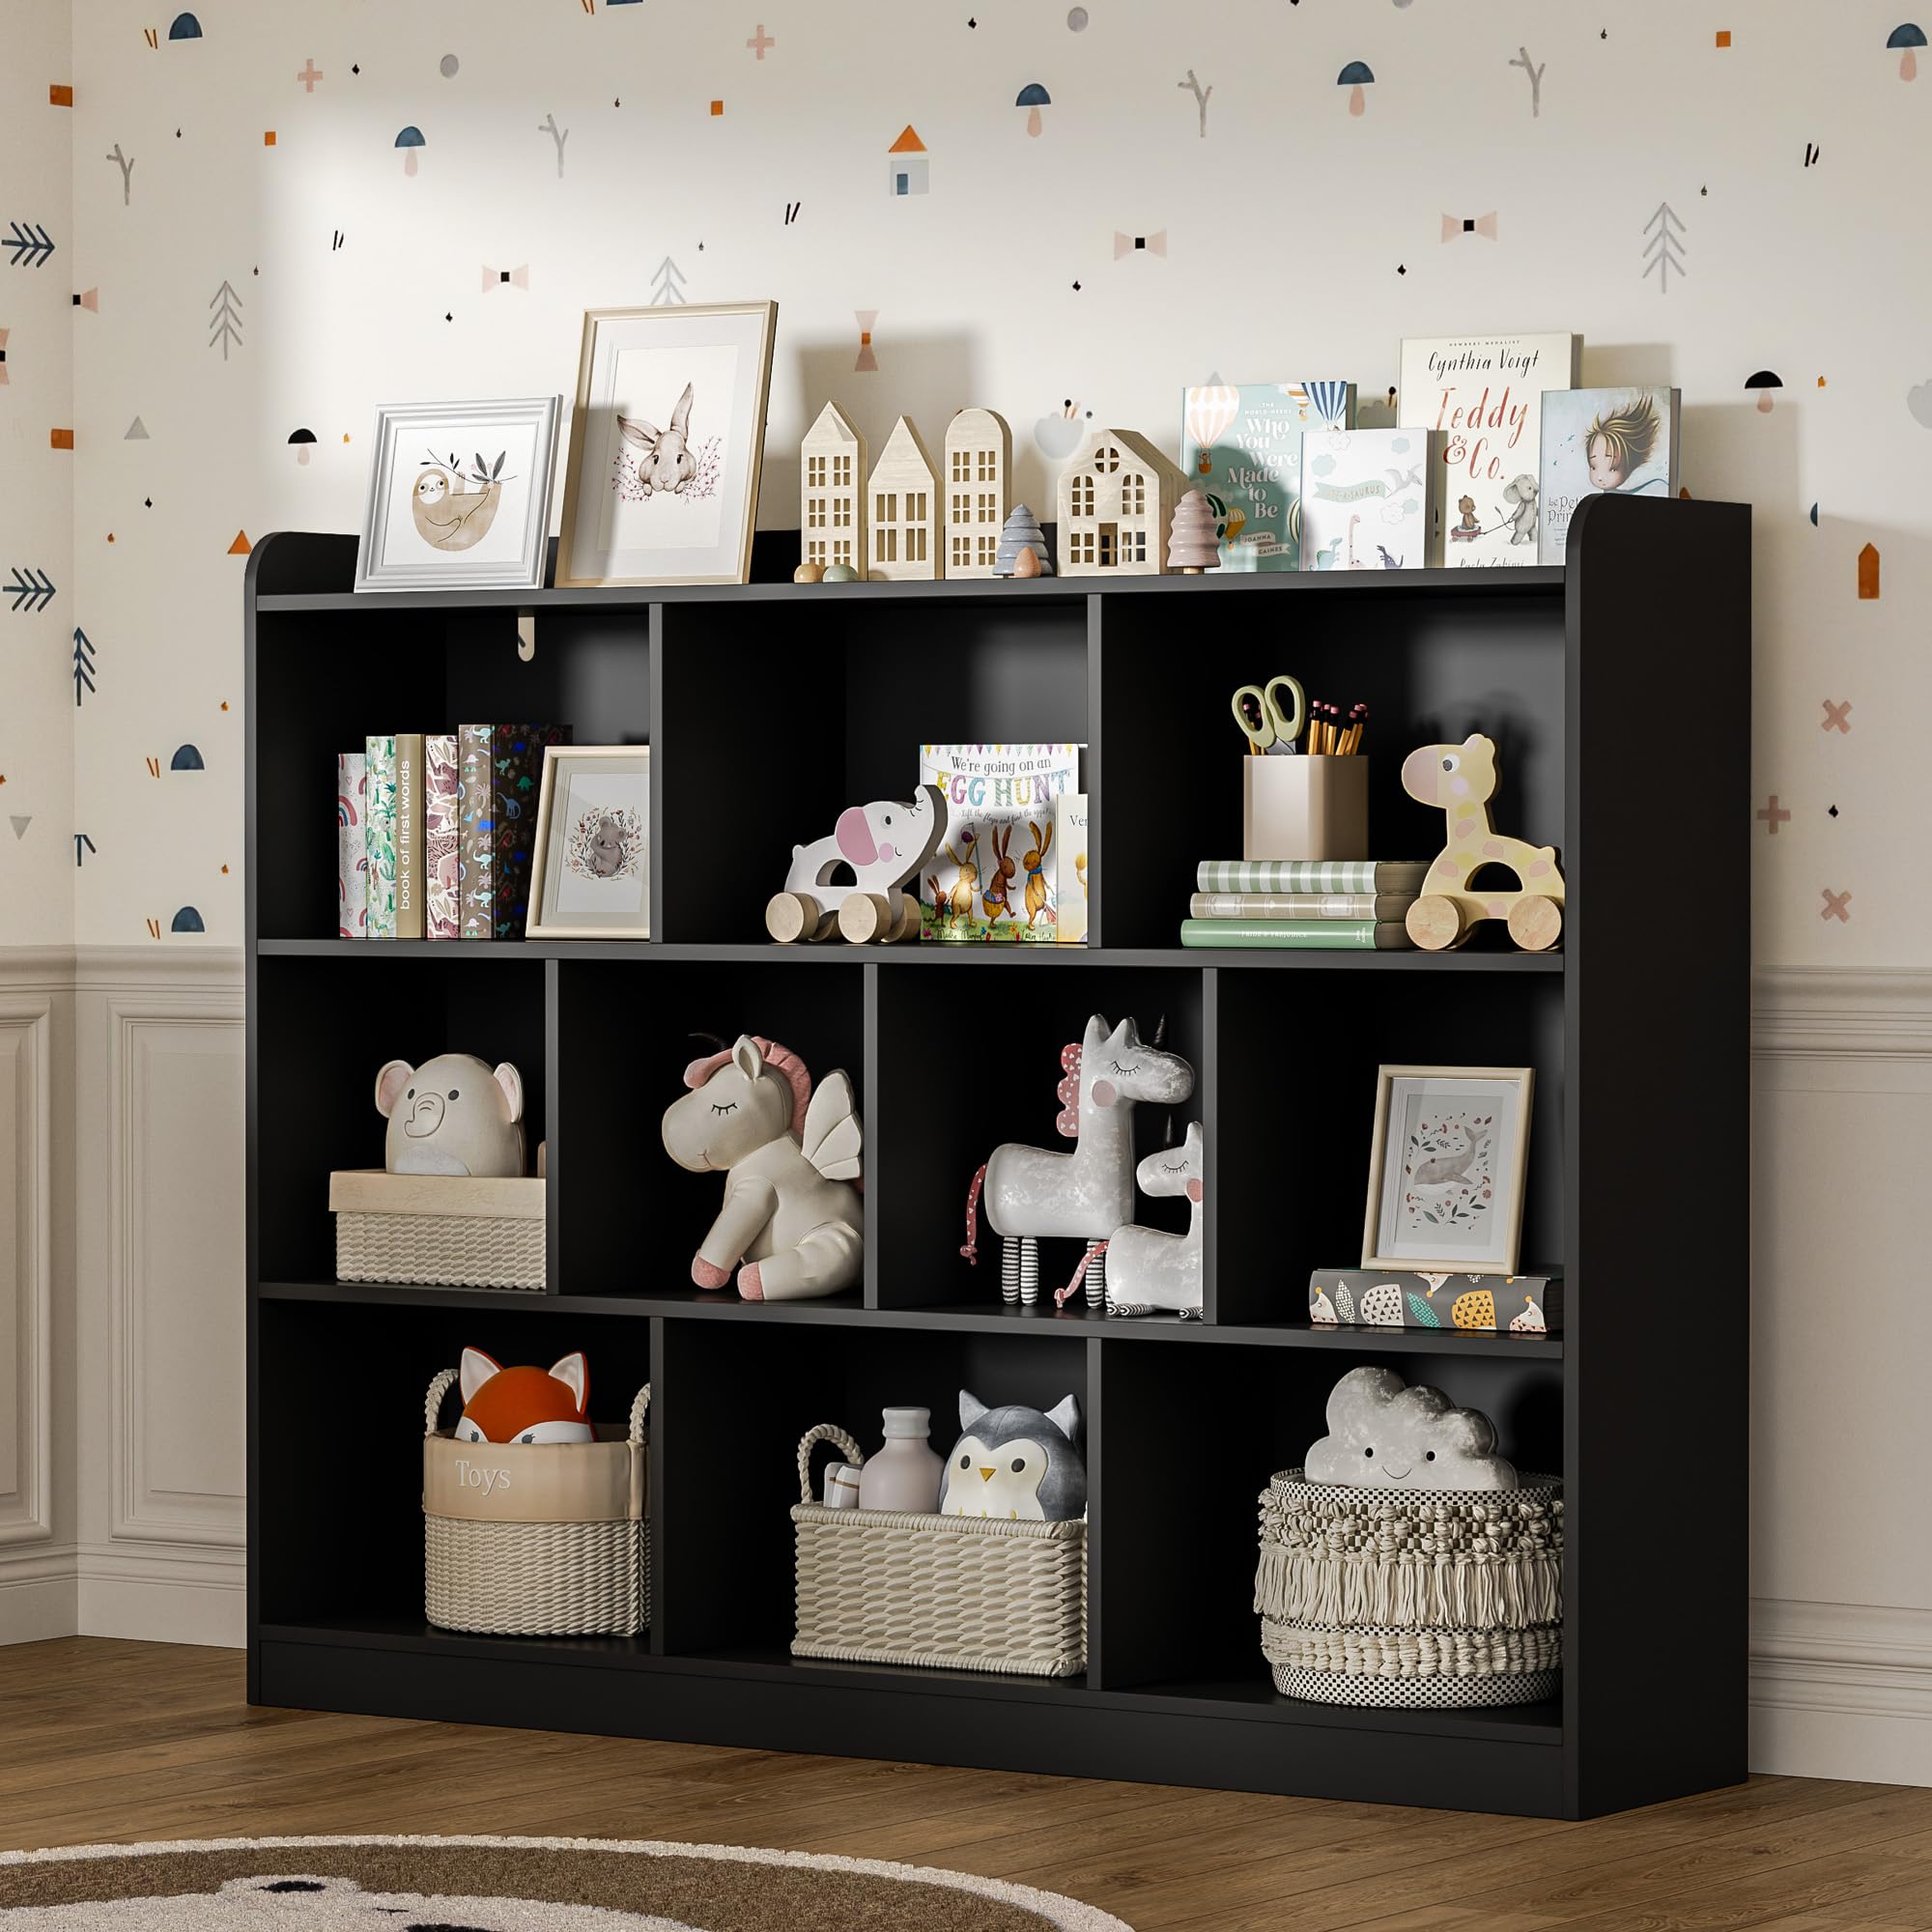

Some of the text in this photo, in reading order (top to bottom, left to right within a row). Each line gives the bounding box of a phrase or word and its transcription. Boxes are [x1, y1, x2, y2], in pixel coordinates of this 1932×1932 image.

[1428, 348, 1539, 382] Cynthia Voigt
[1436, 386, 1528, 449] Teddy
[1246, 418, 1290, 440] Who
[1236, 433, 1270, 449] You
[1249, 451, 1298, 467] Were
[1442, 435, 1505, 480] & Co.
[1228, 467, 1279, 490] Made
[1248, 487, 1266, 501] to
[1548, 497, 1558, 506] Le
[1254, 502, 1278, 519] Be
[951, 755, 1051, 776] We're going on an
[936, 770, 1069, 807] EGG HUNT
[400, 760, 410, 909] book of first words
[455, 1460, 511, 1496] Toys
